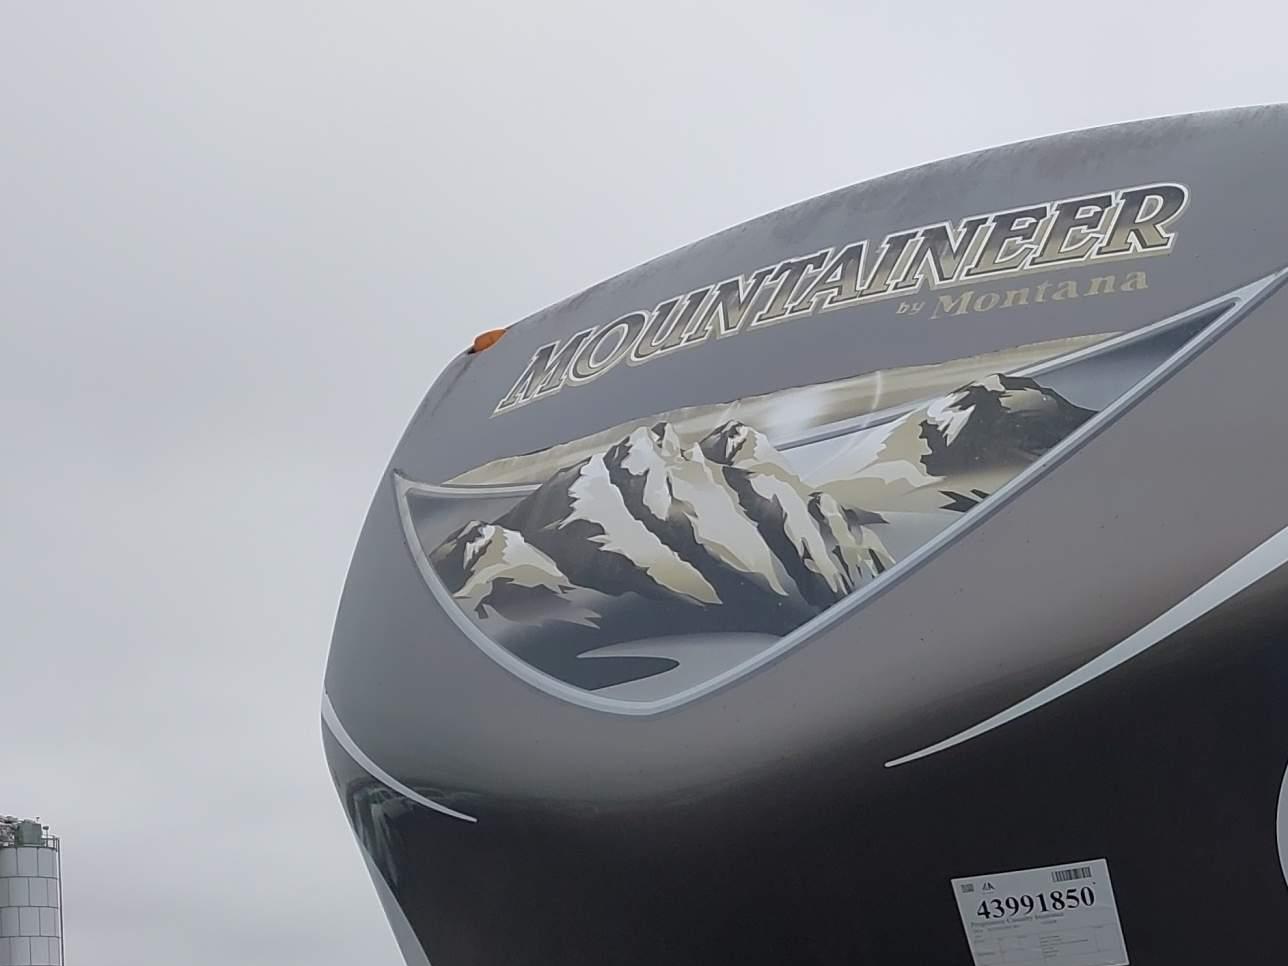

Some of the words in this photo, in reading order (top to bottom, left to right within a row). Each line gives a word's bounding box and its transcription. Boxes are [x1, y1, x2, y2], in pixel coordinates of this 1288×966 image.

[491, 182, 1191, 417] MOUNTAINEER
[896, 301, 926, 315] by
[929, 270, 1150, 320] Montana
[976, 886, 1096, 920] 43991850
